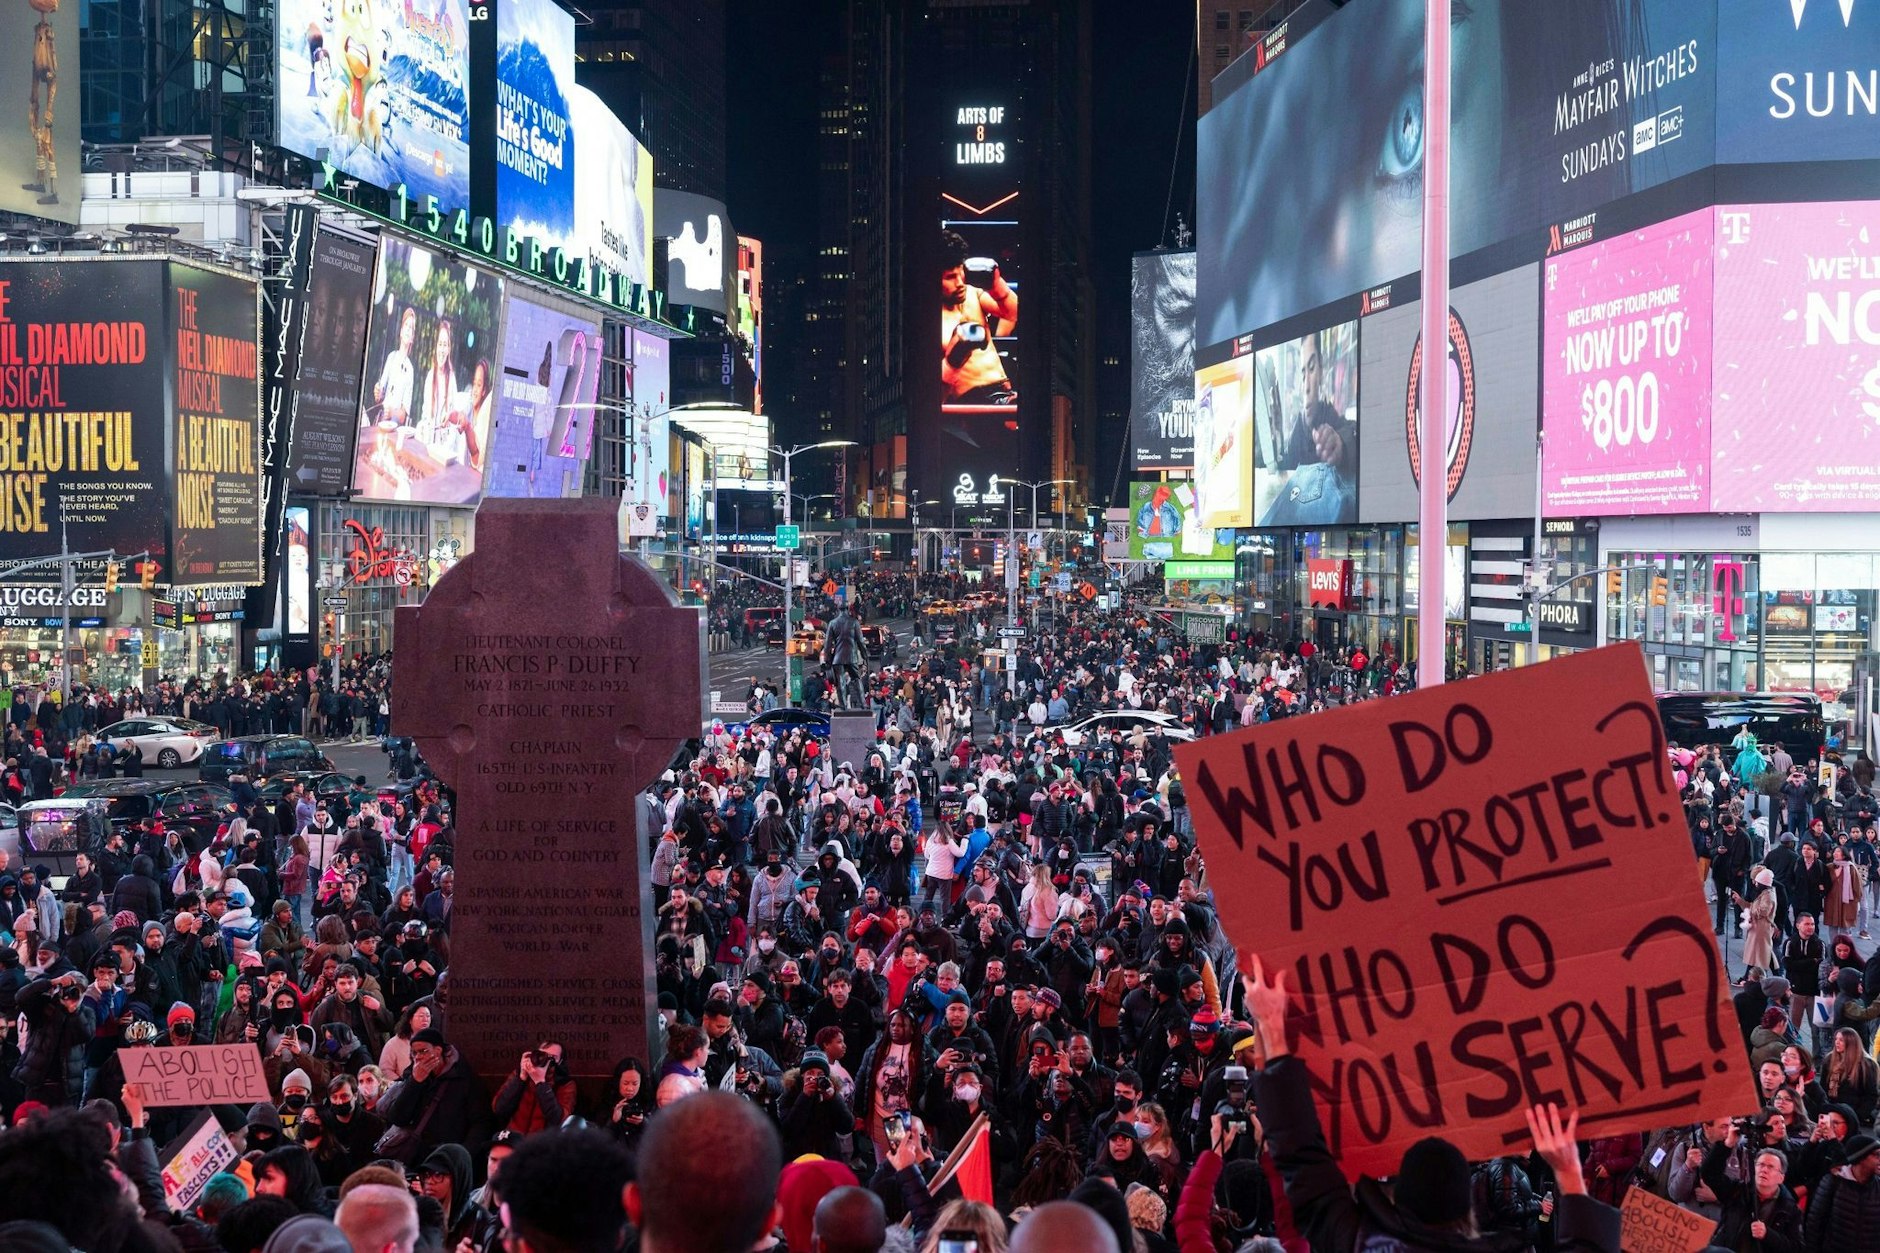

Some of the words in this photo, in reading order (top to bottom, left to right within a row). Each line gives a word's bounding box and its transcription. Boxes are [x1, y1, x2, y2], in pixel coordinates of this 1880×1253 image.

[469, 6, 488, 21] LG
[1573, 73, 1588, 88] ANNE
[1595, 58, 1615, 77] RICE'S
[1769, 70, 1877, 119] SUN
[497, 79, 538, 125] WHAT'S
[540, 105, 566, 142] YOUR
[957, 107, 987, 125] ARTS
[989, 107, 1005, 124] OF
[497, 104, 530, 149] Life's
[530, 126, 562, 170] Good
[976, 125, 985, 142] 8
[497, 136, 548, 186] MOMENT?
[956, 142, 1005, 164] LIMBS
[1562, 131, 1625, 183] SUNDAYS
[1564, 213, 1596, 233] MARRIOTT
[1563, 228, 1592, 247] MARQUIS
[505, 225, 663, 320] BROADWAY
[177, 288, 198, 330] THE
[1567, 310, 1591, 329] WE'LL
[1591, 306, 1607, 324] PAY
[1608, 301, 1623, 320] OFF
[1624, 295, 1647, 316] YOUR
[1648, 284, 1680, 309] PHONE
[28, 322, 146, 365] DIAMOND
[1566, 326, 1615, 375] NOW
[1619, 320, 1648, 365] UP
[1652, 311, 1684, 359] TO
[178, 328, 204, 370] NEIL
[205, 334, 256, 379] DIAMOND
[721, 344, 730, 385] 1500
[178, 369, 223, 414] MUSICAL
[1581, 371, 1659, 450] $800
[177, 414, 187, 472] A
[189, 417, 254, 474] BEAUTIFUL
[1834, 467, 1876, 475] VIRTUAL
[177, 473, 216, 529] NOISE
[1546, 521, 1574, 533] SEPHORA
[1736, 525, 1751, 537] 1535
[203, 585, 246, 601] LUGGAGE
[4, 618, 38, 626] SONY
[215, 612, 231, 620] SONY
[1528, 602, 1579, 625] SPHORA
[466, 635, 550, 650] LIEUTENANT
[556, 636, 625, 650] COLONEL
[454, 655, 540, 674] FRANCIS
[568, 655, 641, 674] DUFFY
[464, 679, 492, 692] MAY
[496, 680, 503, 692] 2
[581, 680, 595, 692] 26
[599, 680, 629, 692] 1932
[477, 704, 553, 718] CATHOLIC
[562, 704, 616, 718] PRIEST
[510, 741, 582, 754] CHAPLAIN
[478, 763, 516, 775] 165TH
[551, 763, 617, 775] INFANTRY
[1197, 741, 1366, 849] WHO
[1388, 703, 1494, 793] DO
[496, 781, 526, 794] OLD
[530, 781, 564, 794] 69TH
[1257, 830, 1390, 931] YOU
[1408, 701, 1671, 892] PROTECT?
[480, 821, 490, 833] A
[496, 821, 526, 833] LIFE
[531, 821, 550, 833] OF
[557, 821, 617, 833] SERVICE
[534, 836, 558, 846] FOR
[472, 850, 508, 863] GOD
[512, 850, 544, 862] AND
[550, 850, 621, 863] COUNTRY
[469, 888, 520, 899] SPANISH
[524, 888, 591, 899] AMERICAN
[595, 888, 624, 899] WAR
[454, 905, 483, 916] NEW
[487, 905, 519, 916] YORK
[526, 905, 589, 916] NATIONAL
[594, 905, 640, 917] GUARD
[488, 923, 547, 935] MEXICAN
[552, 923, 604, 935] BORDER
[503, 941, 551, 952] WORLD
[561, 941, 590, 952] WAR
[1430, 914, 1556, 1015] DO
[451, 978, 544, 989] DISTINGUISHED
[550, 978, 596, 989] SERVICE
[602, 978, 642, 989] CROSS
[451, 995, 544, 1007] DISTINGUISHED
[550, 995, 596, 1007] SERVICE
[602, 996, 641, 1007] MEDAL
[451, 1014, 542, 1025] CONSPICUOUS
[550, 1014, 596, 1025] SERVICE
[602, 1014, 642, 1025] CROSS
[1450, 915, 1728, 1119] SERVE?
[483, 1031, 529, 1042] LEGION
[138, 1048, 257, 1078] ABOLISH
[133, 1080, 181, 1102] THE
[187, 1074, 264, 1100] POLICE
